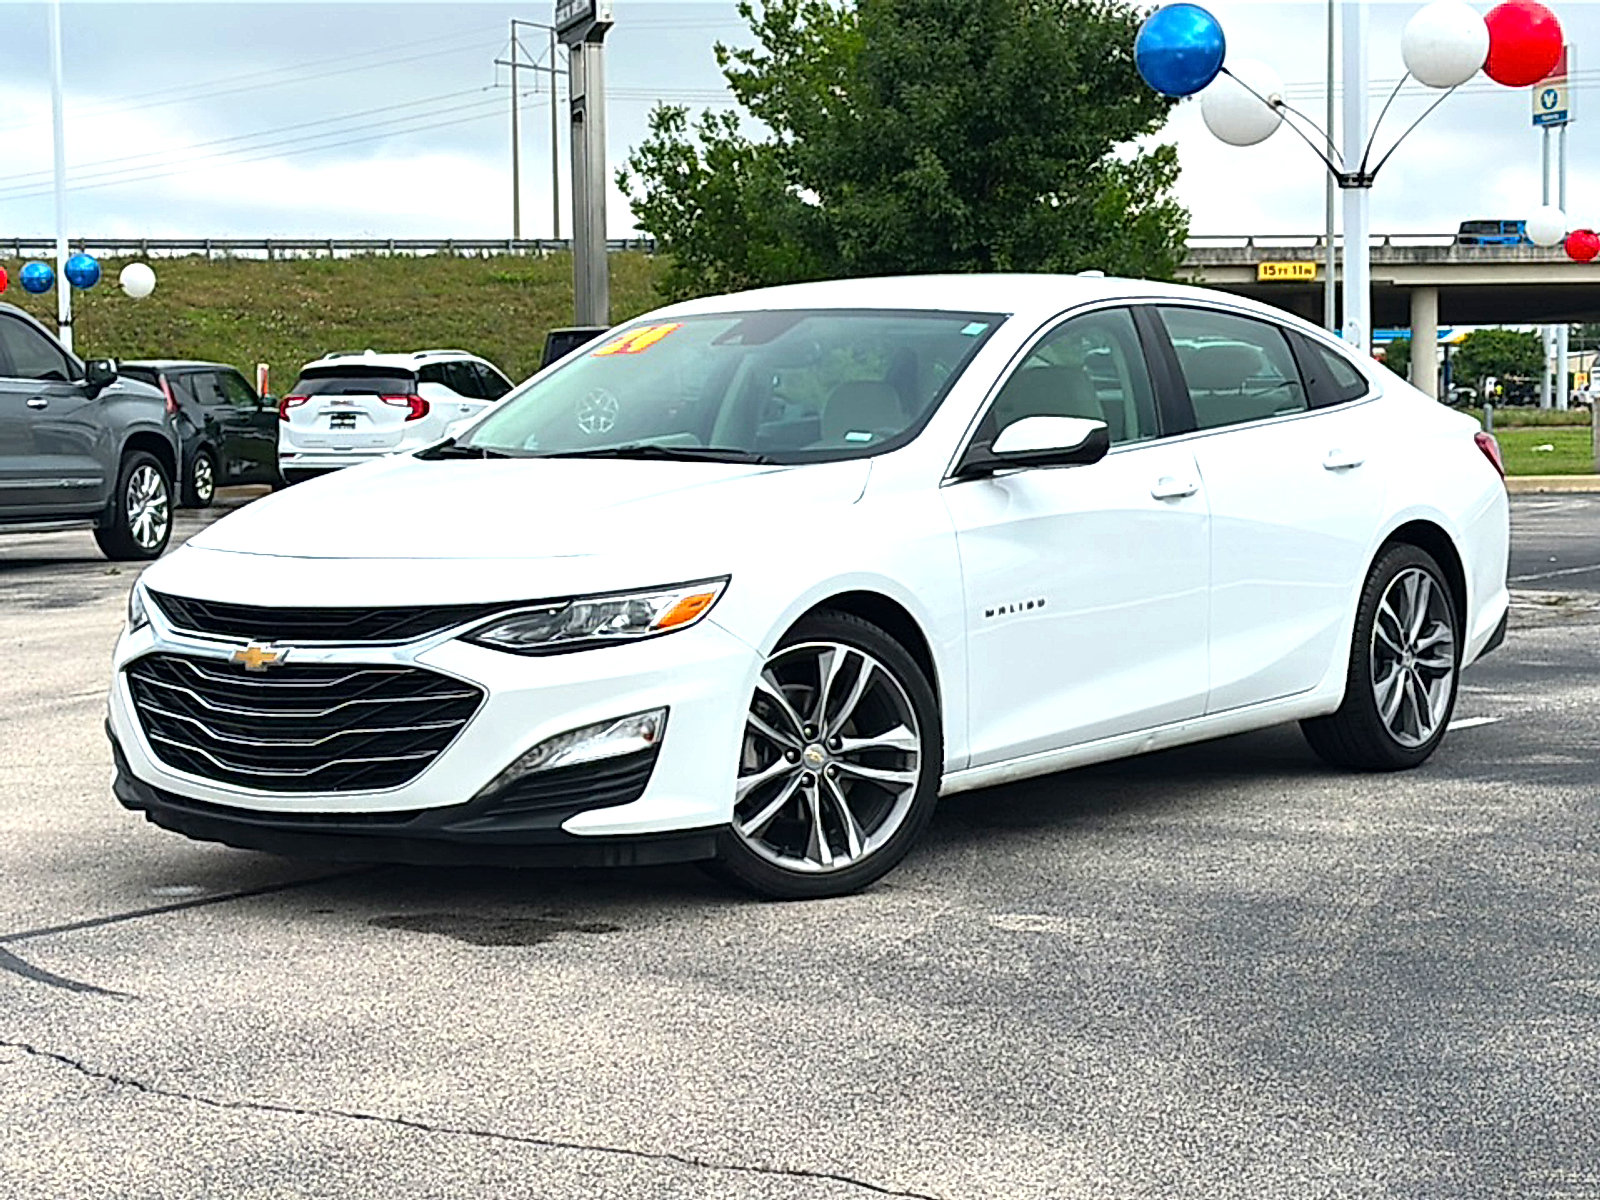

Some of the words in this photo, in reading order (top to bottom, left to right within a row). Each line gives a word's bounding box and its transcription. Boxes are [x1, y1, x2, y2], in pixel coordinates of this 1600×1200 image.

[1263, 265, 1276, 275] 15
[1293, 265, 1303, 275] 11
[985, 599, 1045, 617] MALIBU
